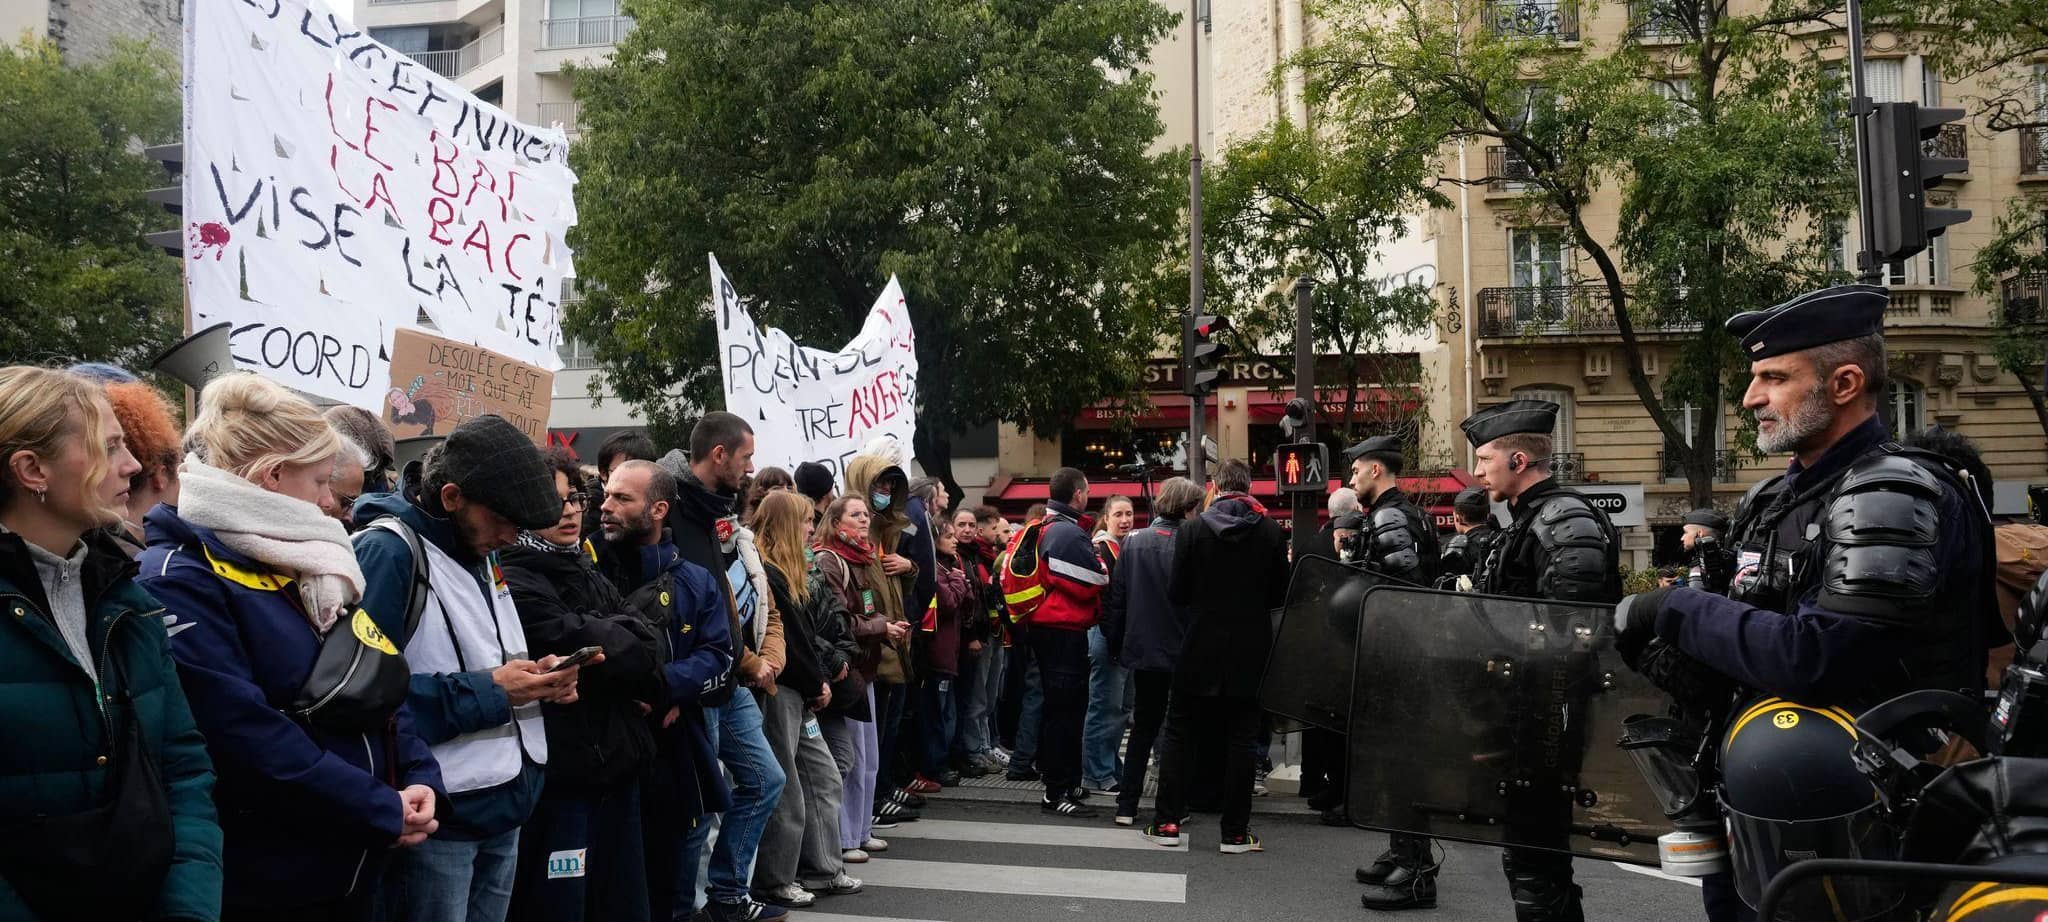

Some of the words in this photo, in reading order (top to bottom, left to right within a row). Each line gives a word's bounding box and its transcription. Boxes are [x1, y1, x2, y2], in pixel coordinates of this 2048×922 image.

[331, 144, 404, 230] LA
[402, 236, 472, 312] LA
[428, 197, 531, 281] BAC
